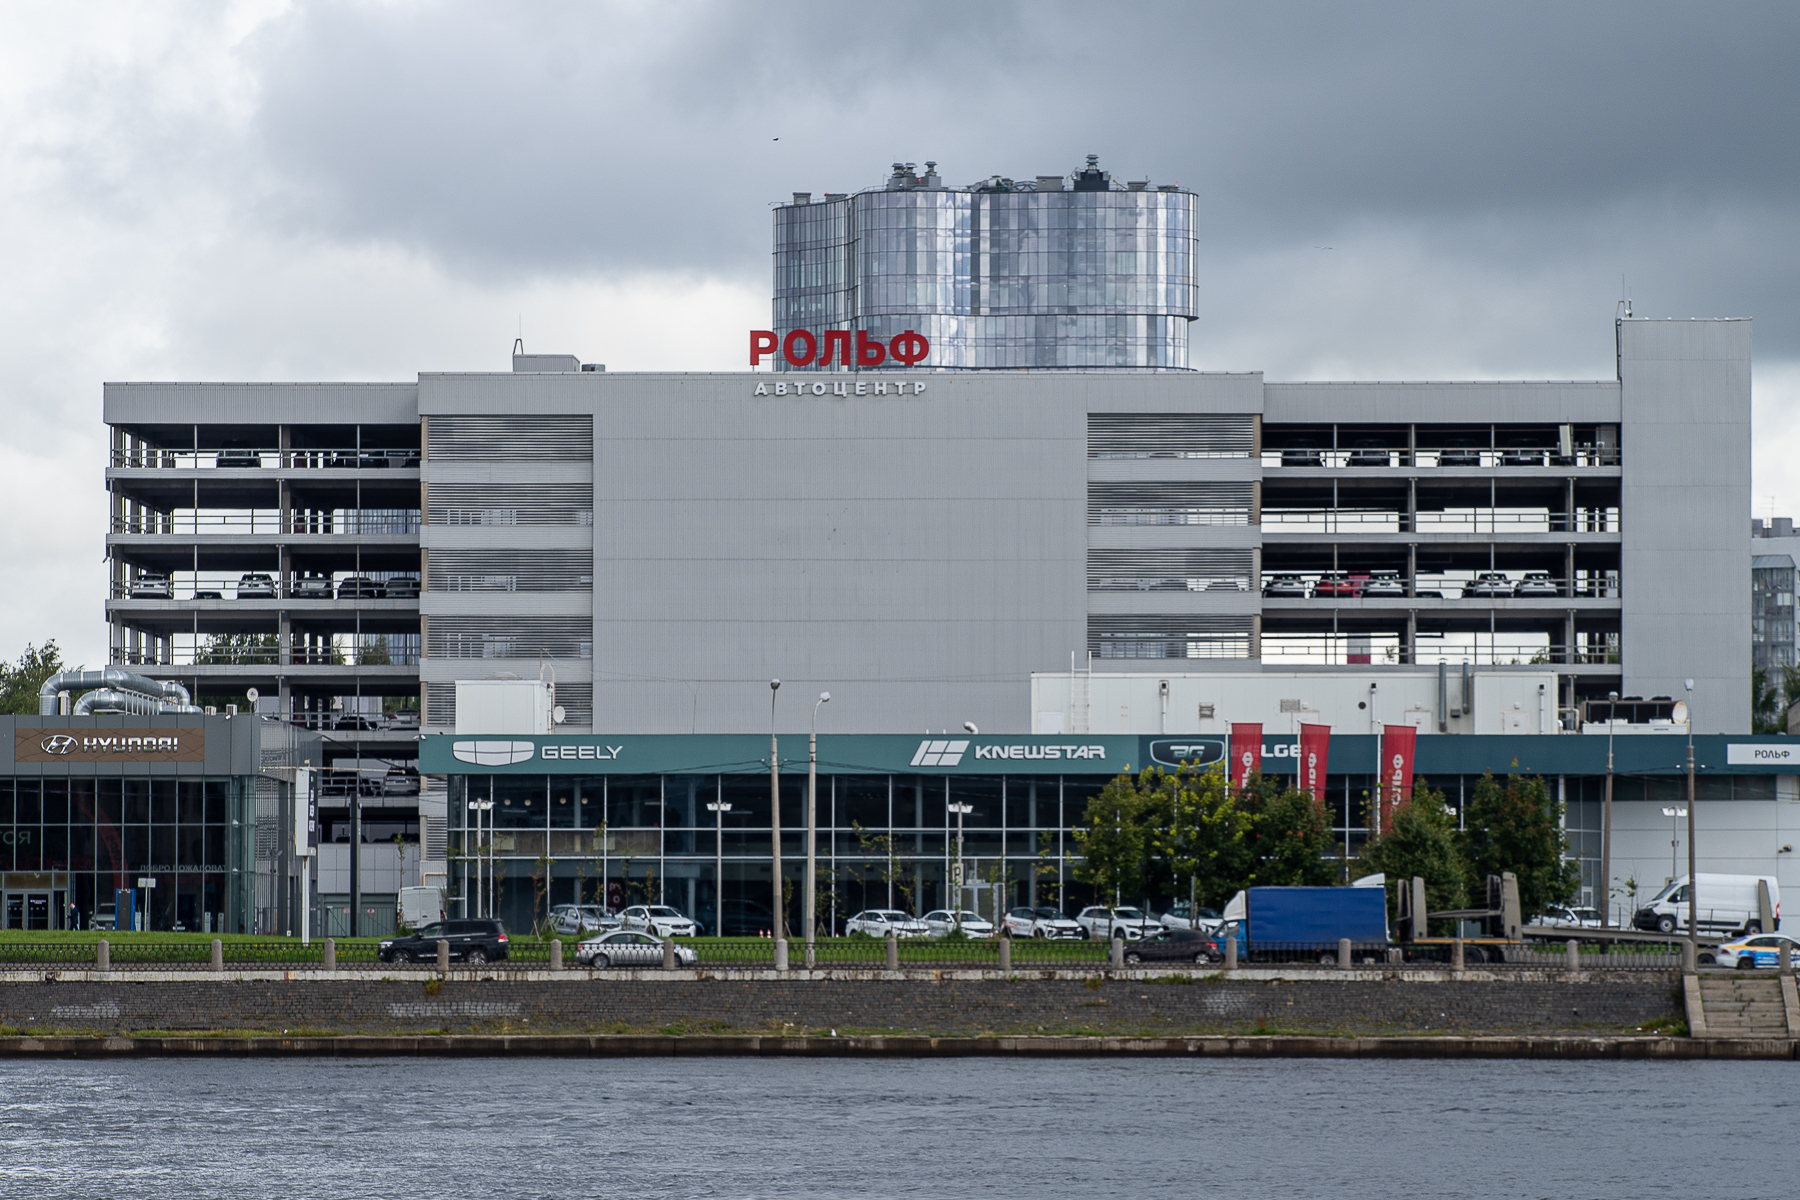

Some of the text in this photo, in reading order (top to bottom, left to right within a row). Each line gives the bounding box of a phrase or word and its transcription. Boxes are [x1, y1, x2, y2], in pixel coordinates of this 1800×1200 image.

[750, 329, 930, 366] РОЛЬФ
[754, 381, 927, 398] АВТОЦЕНТР
[83, 737, 179, 752] HYUNDAI
[975, 745, 1106, 759] KNEWSTAR
[541, 745, 623, 760] GEELY
[1754, 750, 1790, 759] РОЛЬФ
